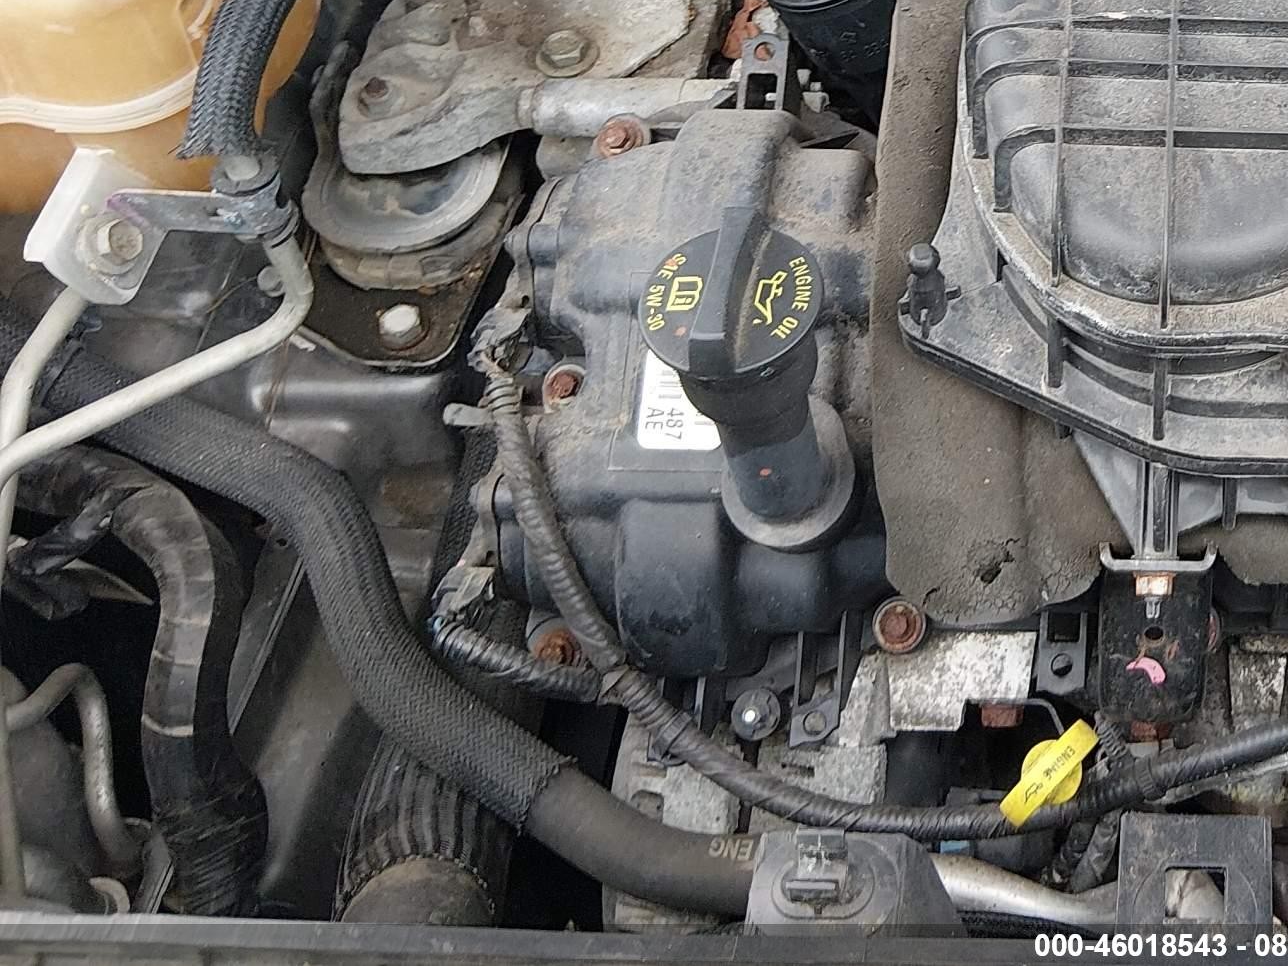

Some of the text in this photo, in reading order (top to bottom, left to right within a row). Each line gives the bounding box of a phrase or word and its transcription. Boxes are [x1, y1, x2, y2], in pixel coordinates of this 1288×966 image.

[643, 284, 666, 331] 5W-30
[770, 256, 814, 339] ENGINE OIL
[645, 407, 664, 429] AE
[708, 836, 754, 861] ENG
